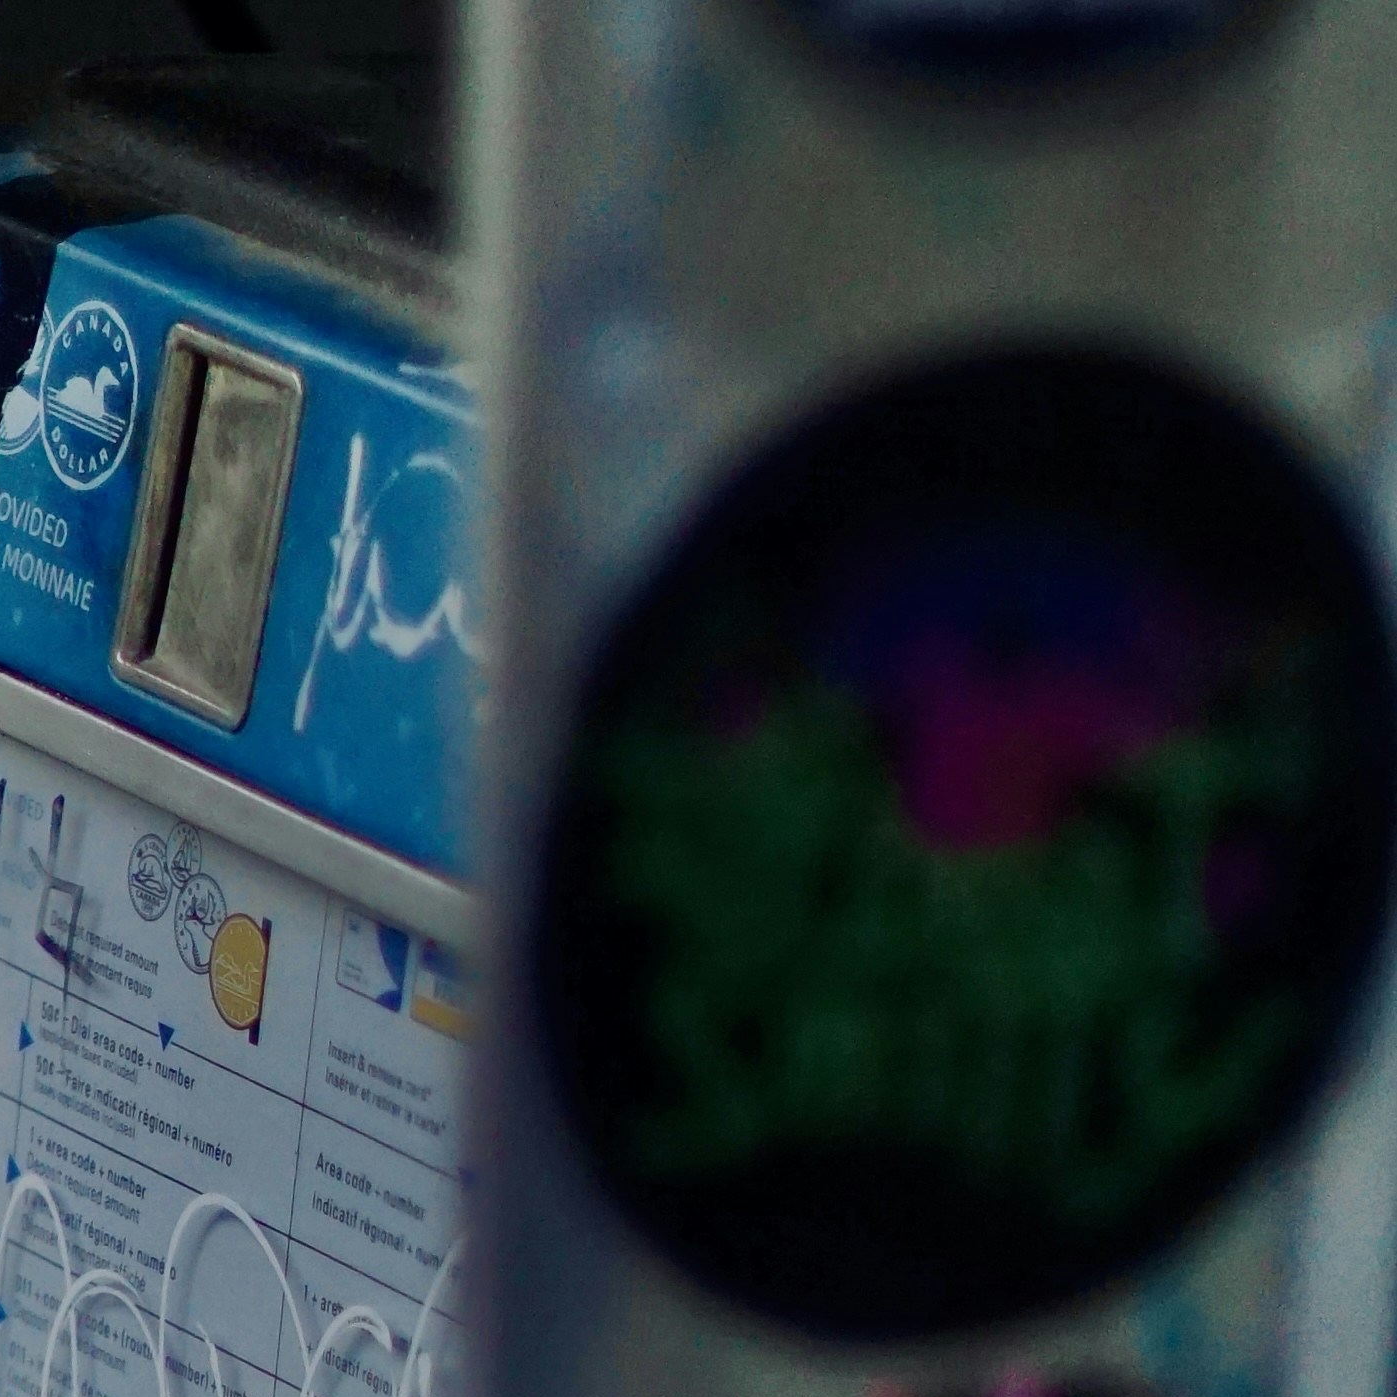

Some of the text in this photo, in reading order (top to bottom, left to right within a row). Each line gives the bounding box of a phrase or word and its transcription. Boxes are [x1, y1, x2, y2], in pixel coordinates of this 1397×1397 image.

[62, 314, 129, 377] CANADA
[51, 425, 110, 475] DOLLAR
[0, 541, 96, 613] MONNAIE
[84, 926, 123, 962] required
[123, 946, 158, 976] amount
[123, 975, 153, 1002] requis
[70, 1014, 91, 1042] Dial
[92, 1028, 116, 1054] area
[118, 1038, 144, 1068] code
[154, 1057, 196, 1092] number
[324, 1064, 359, 1098] Insérer
[326, 1038, 356, 1068] Insert
[64, 1067, 92, 1098] Faire
[93, 1082, 137, 1121] indicatif
[136, 1105, 182, 1145] régional
[191, 1131, 233, 1167] numéro
[44, 1135, 68, 1161] area
[70, 1146, 96, 1175] code
[106, 1164, 147, 1200] number
[315, 1150, 343, 1182] Area
[344, 1165, 372, 1196] code
[103, 1192, 141, 1225] amount
[311, 1188, 358, 1230] Indicatif
[358, 1214, 405, 1256] régional
[82, 1217, 126, 1258] régional
[135, 1244, 178, 1282] numéo
[84, 1309, 111, 1339] code
[163, 1350, 209, 1391] number)
